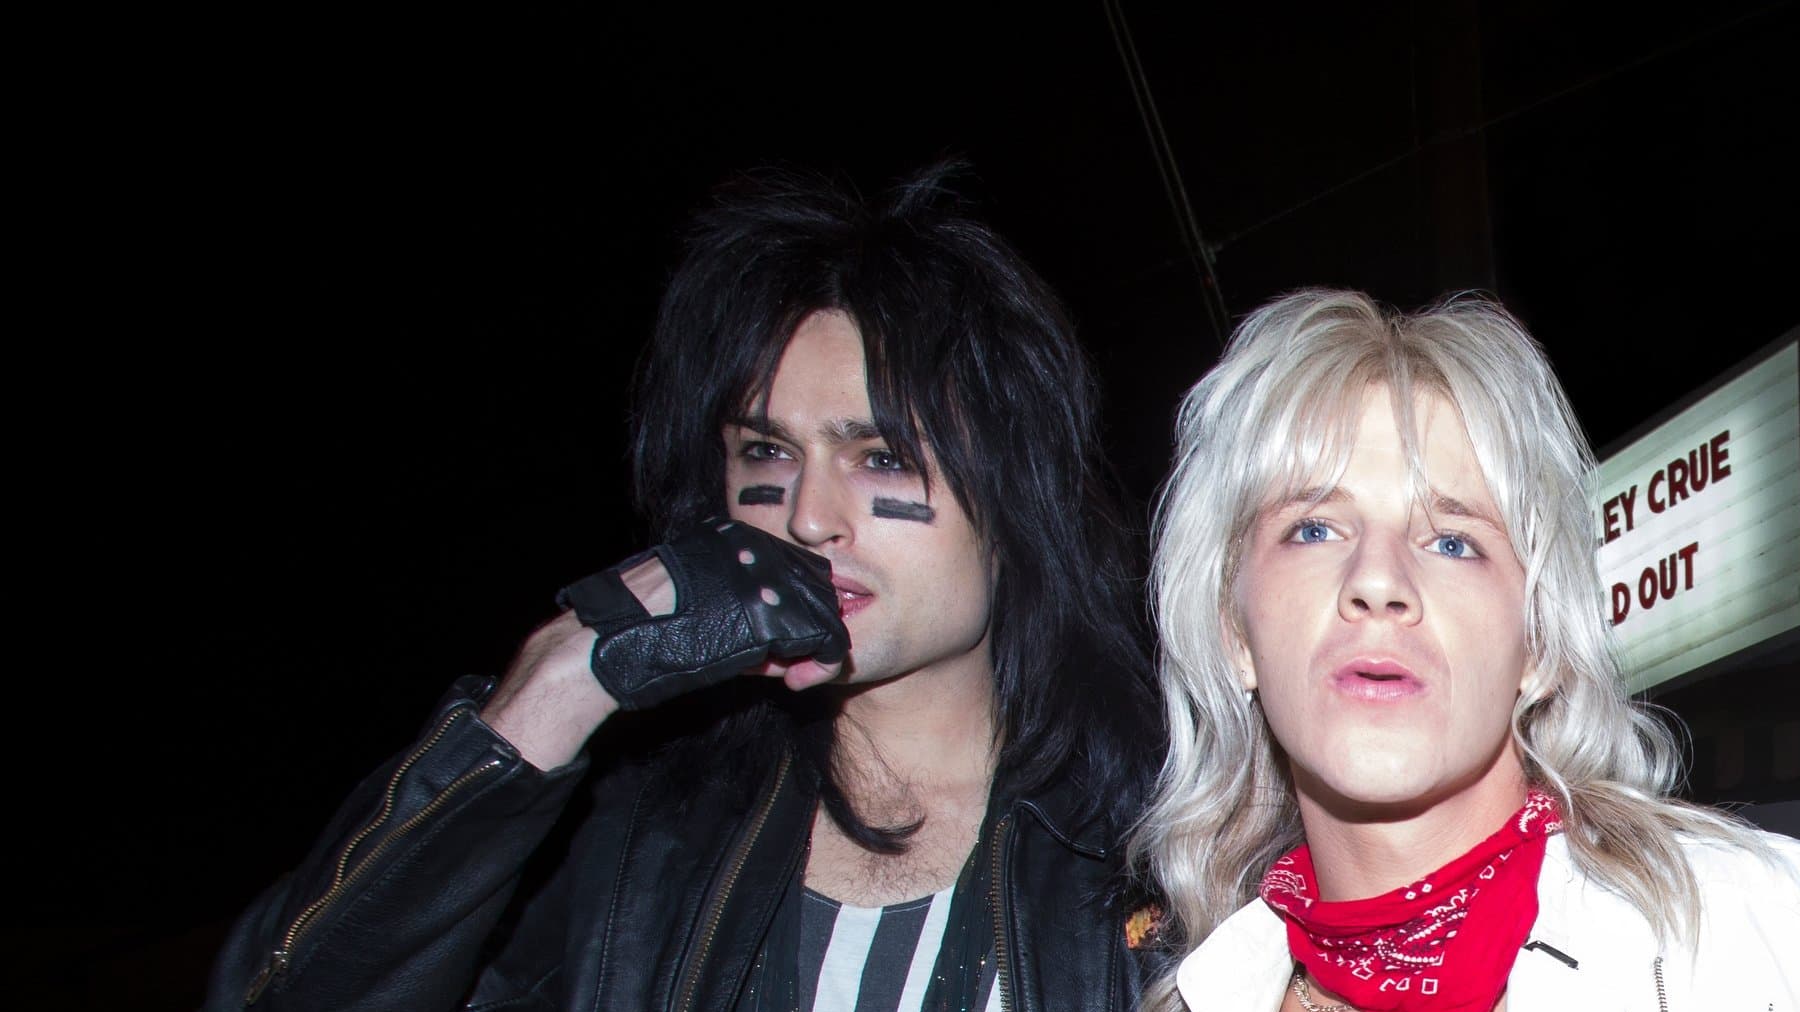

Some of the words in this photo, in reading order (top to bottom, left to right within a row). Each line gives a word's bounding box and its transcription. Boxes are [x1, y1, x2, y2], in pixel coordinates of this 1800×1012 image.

[1597, 484, 1638, 547] EY
[1647, 429, 1732, 514] CRUE
[1608, 582, 1631, 627] D
[1638, 541, 1699, 610] OUT
